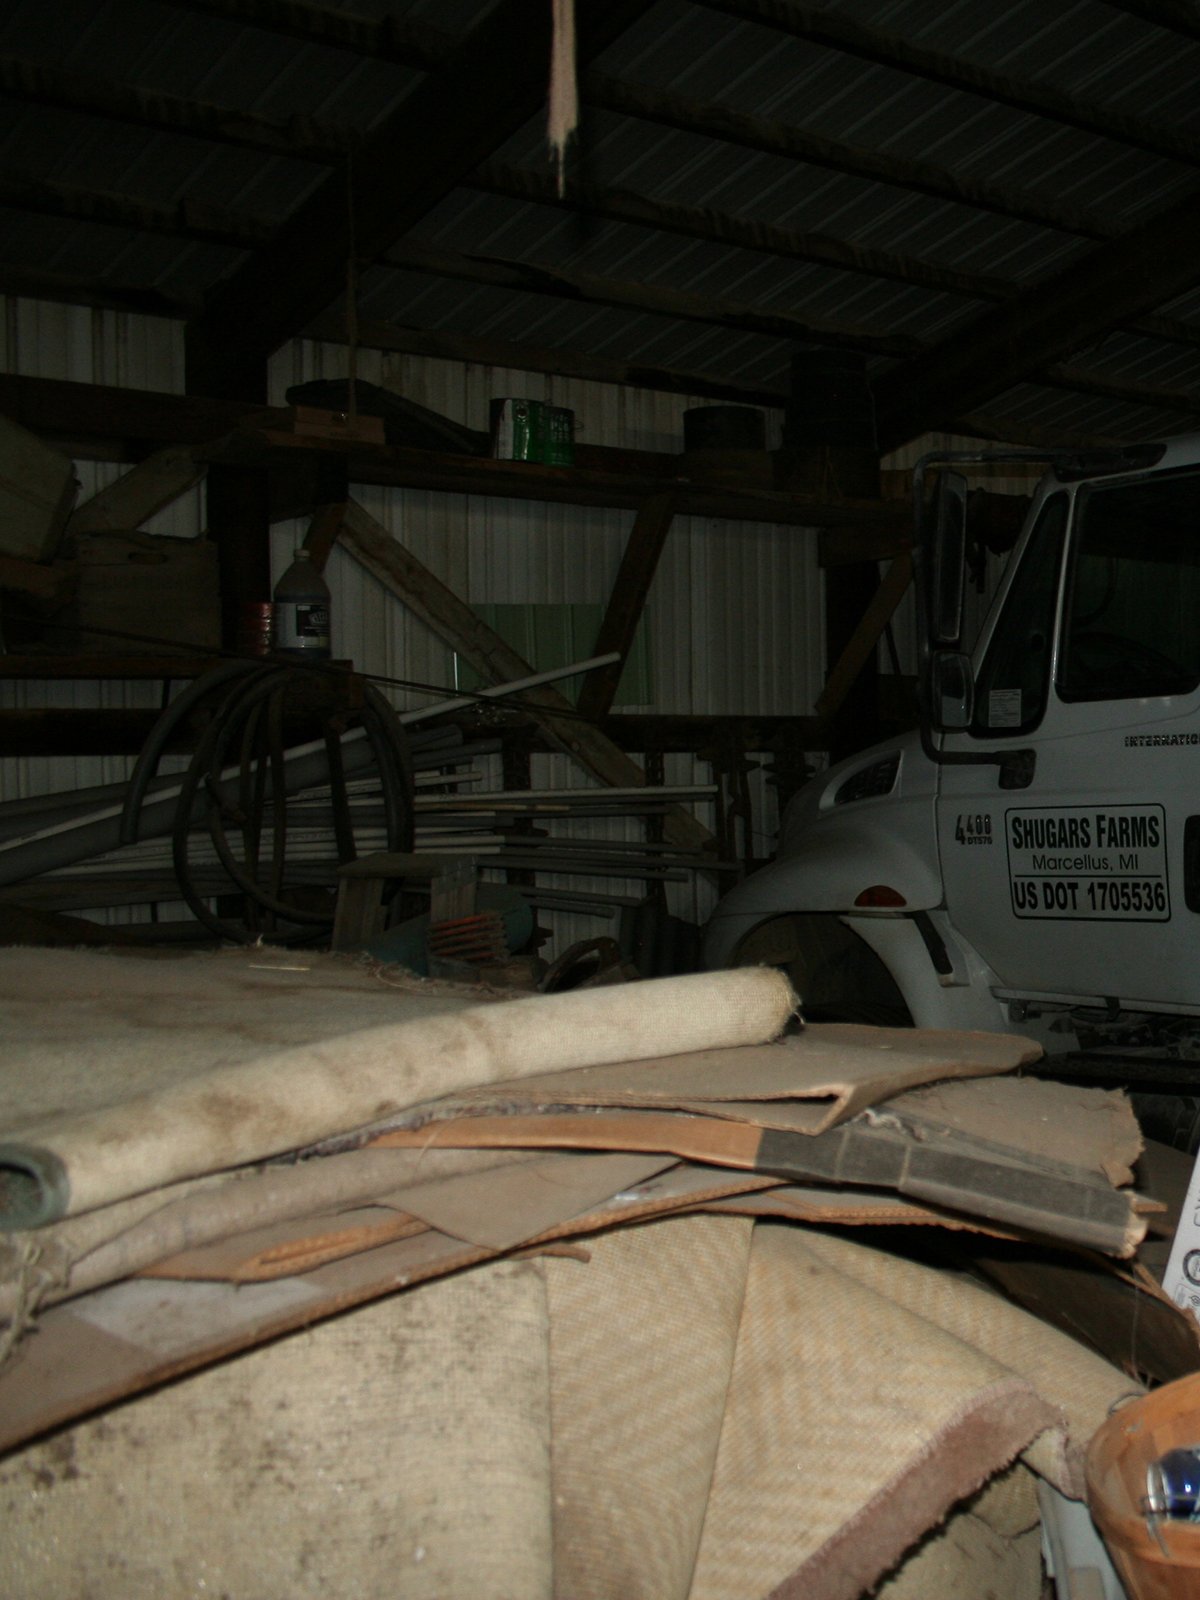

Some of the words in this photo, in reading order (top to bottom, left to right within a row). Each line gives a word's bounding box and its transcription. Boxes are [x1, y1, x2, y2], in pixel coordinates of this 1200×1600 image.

[955, 814, 992, 845] 4400
[1012, 816, 1091, 849] SHUGARS
[1096, 815, 1160, 848] FARMS
[1032, 854, 1114, 871] Marcellus,
[1119, 854, 1139, 870] MI
[1014, 881, 1039, 909] US
[1043, 881, 1079, 910] DOT
[1087, 881, 1166, 911] 1705536
